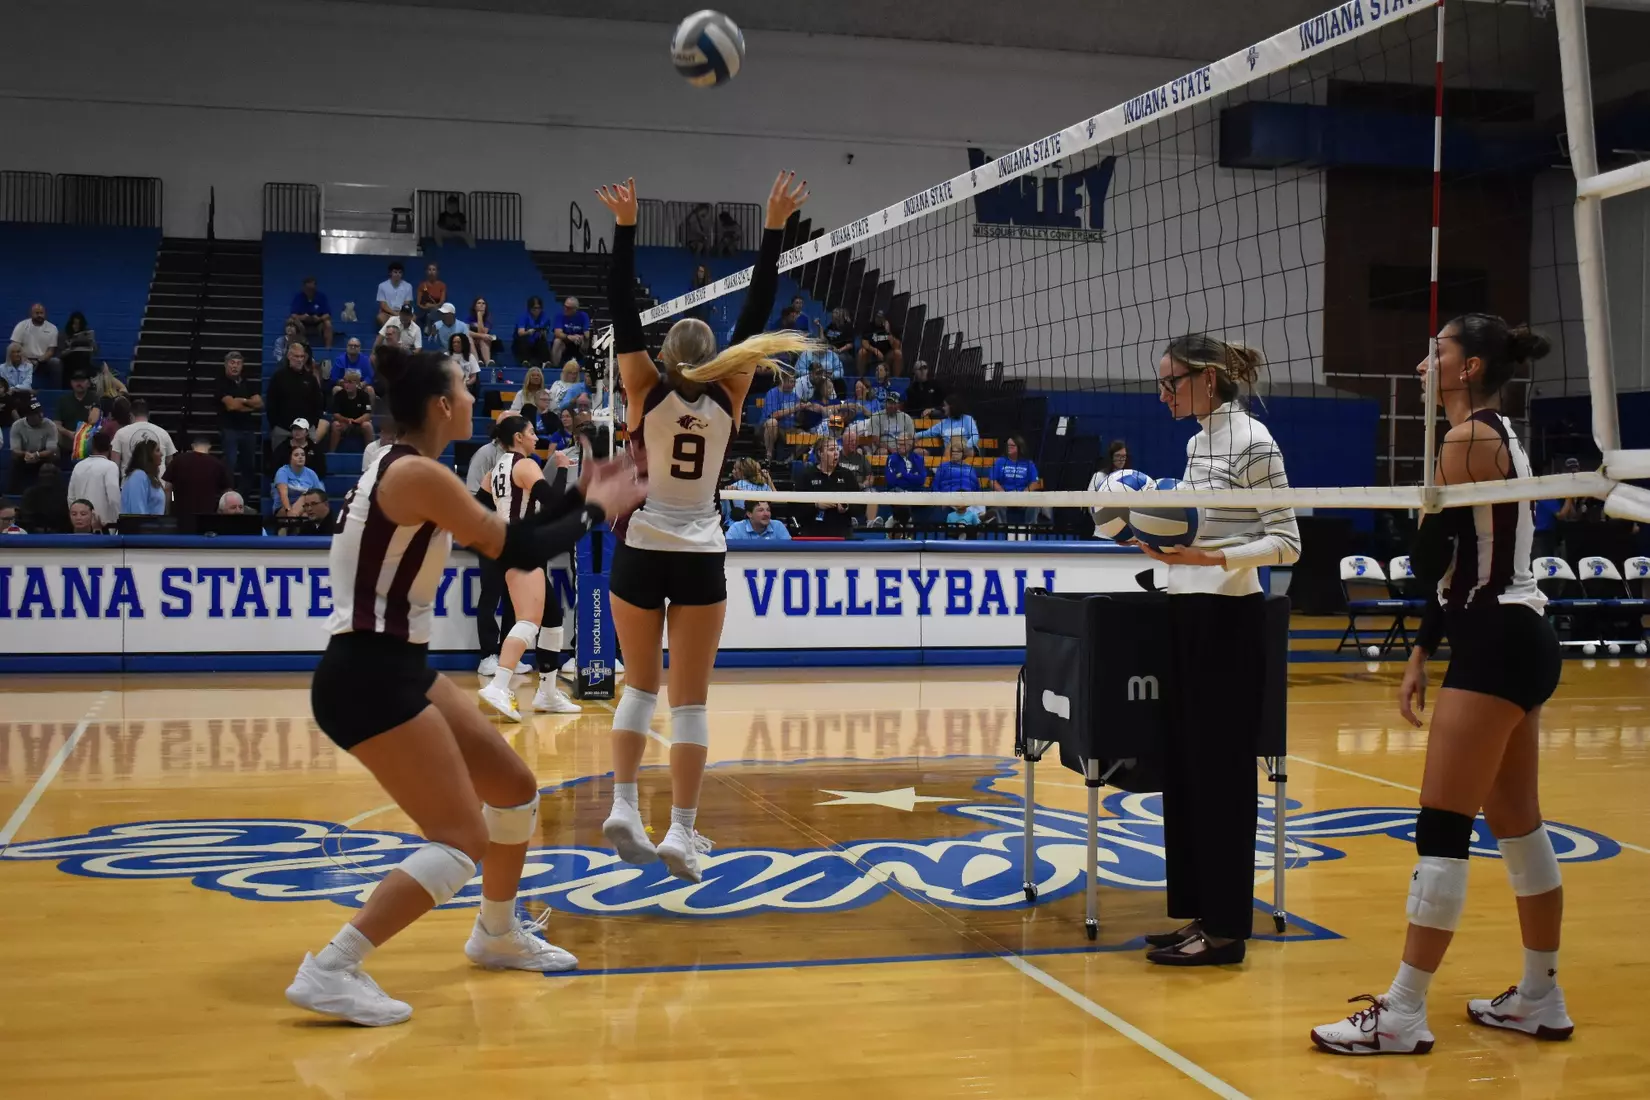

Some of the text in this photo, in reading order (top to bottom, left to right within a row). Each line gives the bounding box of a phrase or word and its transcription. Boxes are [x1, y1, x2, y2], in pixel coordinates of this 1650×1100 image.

[1299, 0, 1364, 51] INDIANA
[1123, 66, 1211, 125] INDIANA STATE
[997, 132, 1061, 178] INDIANA STATE
[930, 181, 953, 206] STATE
[973, 226, 1102, 242] MISSOURI VALLEY CONFERENCE
[670, 433, 705, 480] 9
[492, 473, 506, 498] 13
[161, 567, 334, 617] STATE
[592, 588, 602, 655] sports imports
